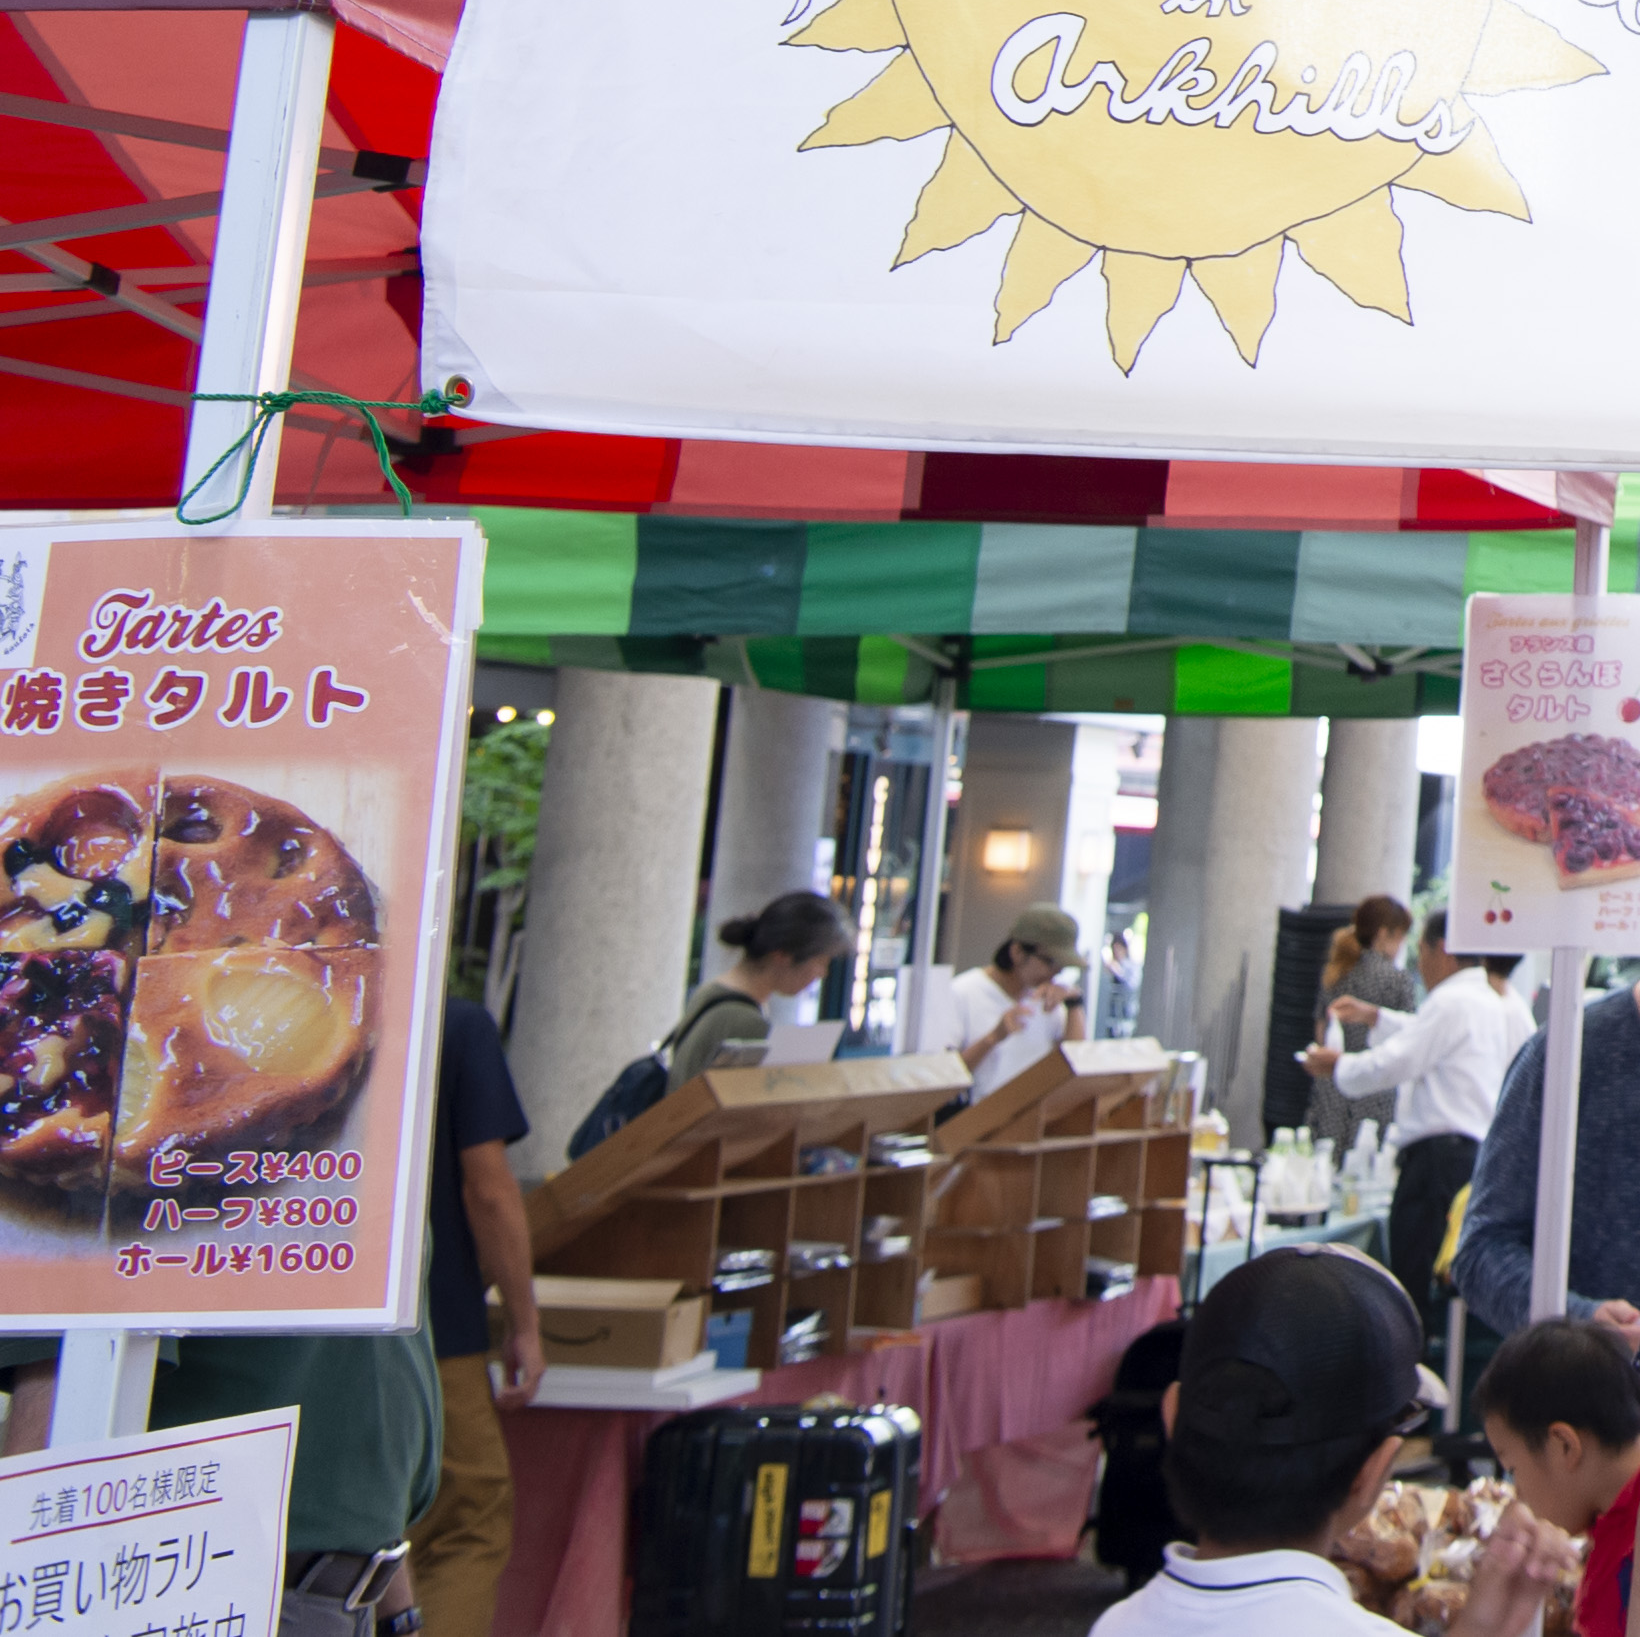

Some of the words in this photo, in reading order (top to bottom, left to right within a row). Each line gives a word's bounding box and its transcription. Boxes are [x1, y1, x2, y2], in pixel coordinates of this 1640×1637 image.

[991, 10, 1478, 154] Arkhills
[81, 592, 279, 659] Tartes
[3, 669, 366, 732] 焼きタルト
[1506, 693, 1592, 723] タルト
[29, 1460, 221, 1531] 先着100名様限定
[0, 1530, 235, 1633] お買い物ラリー
